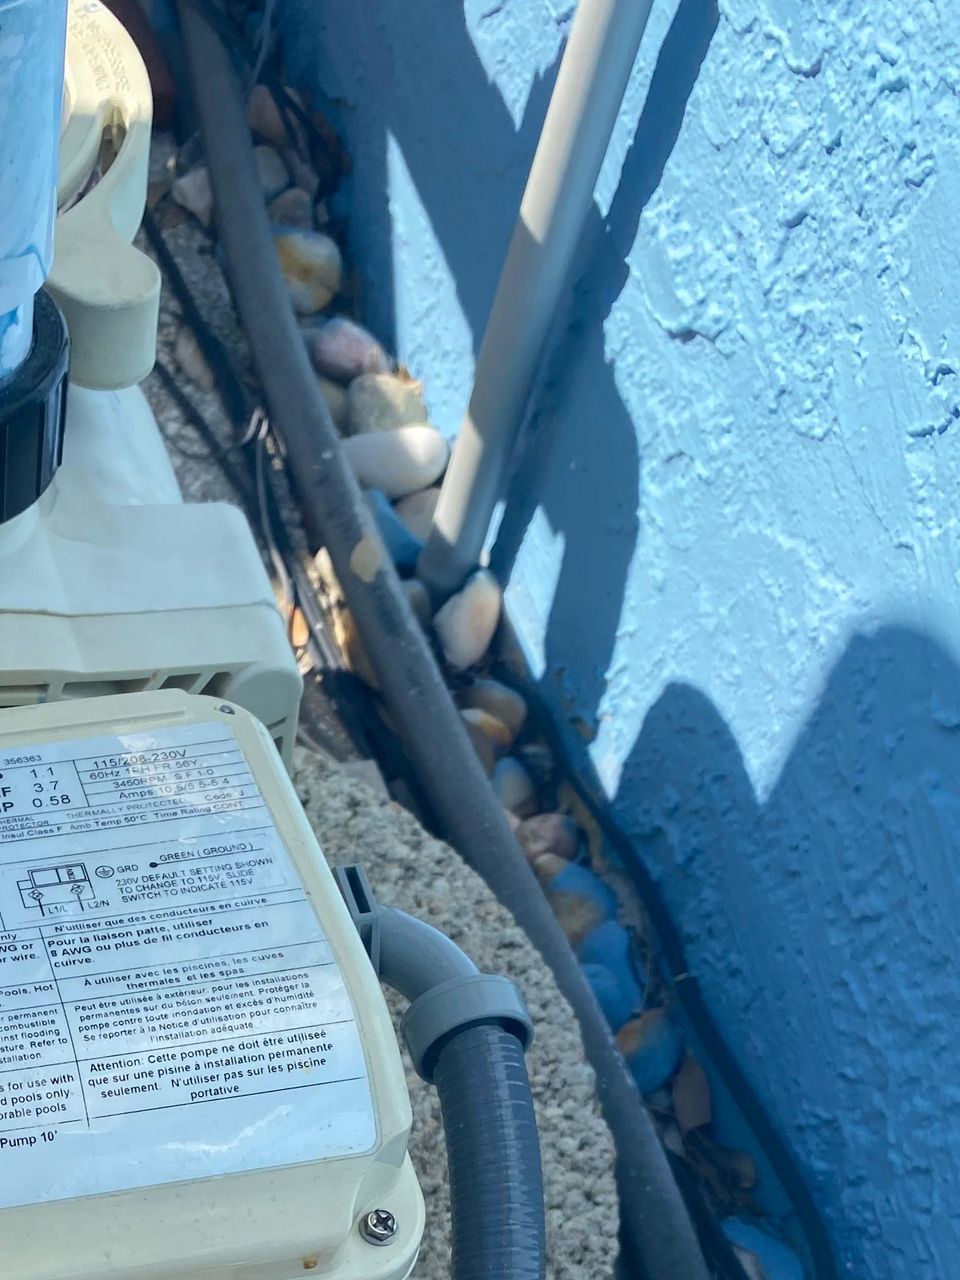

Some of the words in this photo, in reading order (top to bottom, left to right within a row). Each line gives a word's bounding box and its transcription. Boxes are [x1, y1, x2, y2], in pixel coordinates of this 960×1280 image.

[3, 754, 42, 765] 356363
[30, 766, 54, 778] 1.1
[33, 780, 58, 793] 3.7
[32, 794, 71, 808] 0.58
[159, 851, 195, 861] GREEN
[202, 842, 247, 855] GROUND
[115, 876, 138, 886] 230V
[141, 869, 185, 883] DEFAULT
[189, 863, 233, 875] SETTING
[234, 857, 273, 869] SHOWN
[116, 864, 139, 873] GRD
[118, 886, 133, 894] TO
[135, 879, 178, 892] CHANGE
[180, 877, 195, 885] TO
[121, 890, 161, 903] SWITCH
[163, 888, 178, 896] TO
[179, 881, 227, 894] INDICATE
[229, 877, 252, 886] 115V
[47, 938, 76, 948] Pour
[92, 930, 133, 942] liaison
[172, 919, 212, 930] utiliser
[50, 949, 57, 957] 8
[61, 945, 92, 956] AWG
[114, 940, 140, 950] plus
[161, 933, 172, 942] fil
[176, 923, 251, 939] conducteurs
[10, 953, 39, 961] wire.
[33, 983, 53, 992] Hot
[7, 1008, 58, 1022] permanent
[20, 1028, 60, 1039] flooding
[29, 1039, 55, 1048] Refer
[147, 1052, 176, 1063] Cette
[180, 1047, 218, 1061] pompe
[221, 1044, 235, 1053] ne
[238, 1039, 260, 1050] doit
[87, 1076, 108, 1088] que
[112, 1073, 129, 1082] sur
[133, 1070, 154, 1079] une
[157, 1064, 191, 1078] pisine
[268, 1043, 333, 1062] permanente
[223, 1070, 244, 1082] pas
[246, 1067, 263, 1076] sur
[267, 1064, 283, 1073] les
[286, 1057, 326, 1073] piscine
[7, 1081, 23, 1090] for
[26, 1078, 47, 1088] use
[49, 1073, 74, 1085] with
[10, 1092, 42, 1106] pools
[190, 1085, 239, 1101] portative
[0, 1136, 36, 1148] Pump
